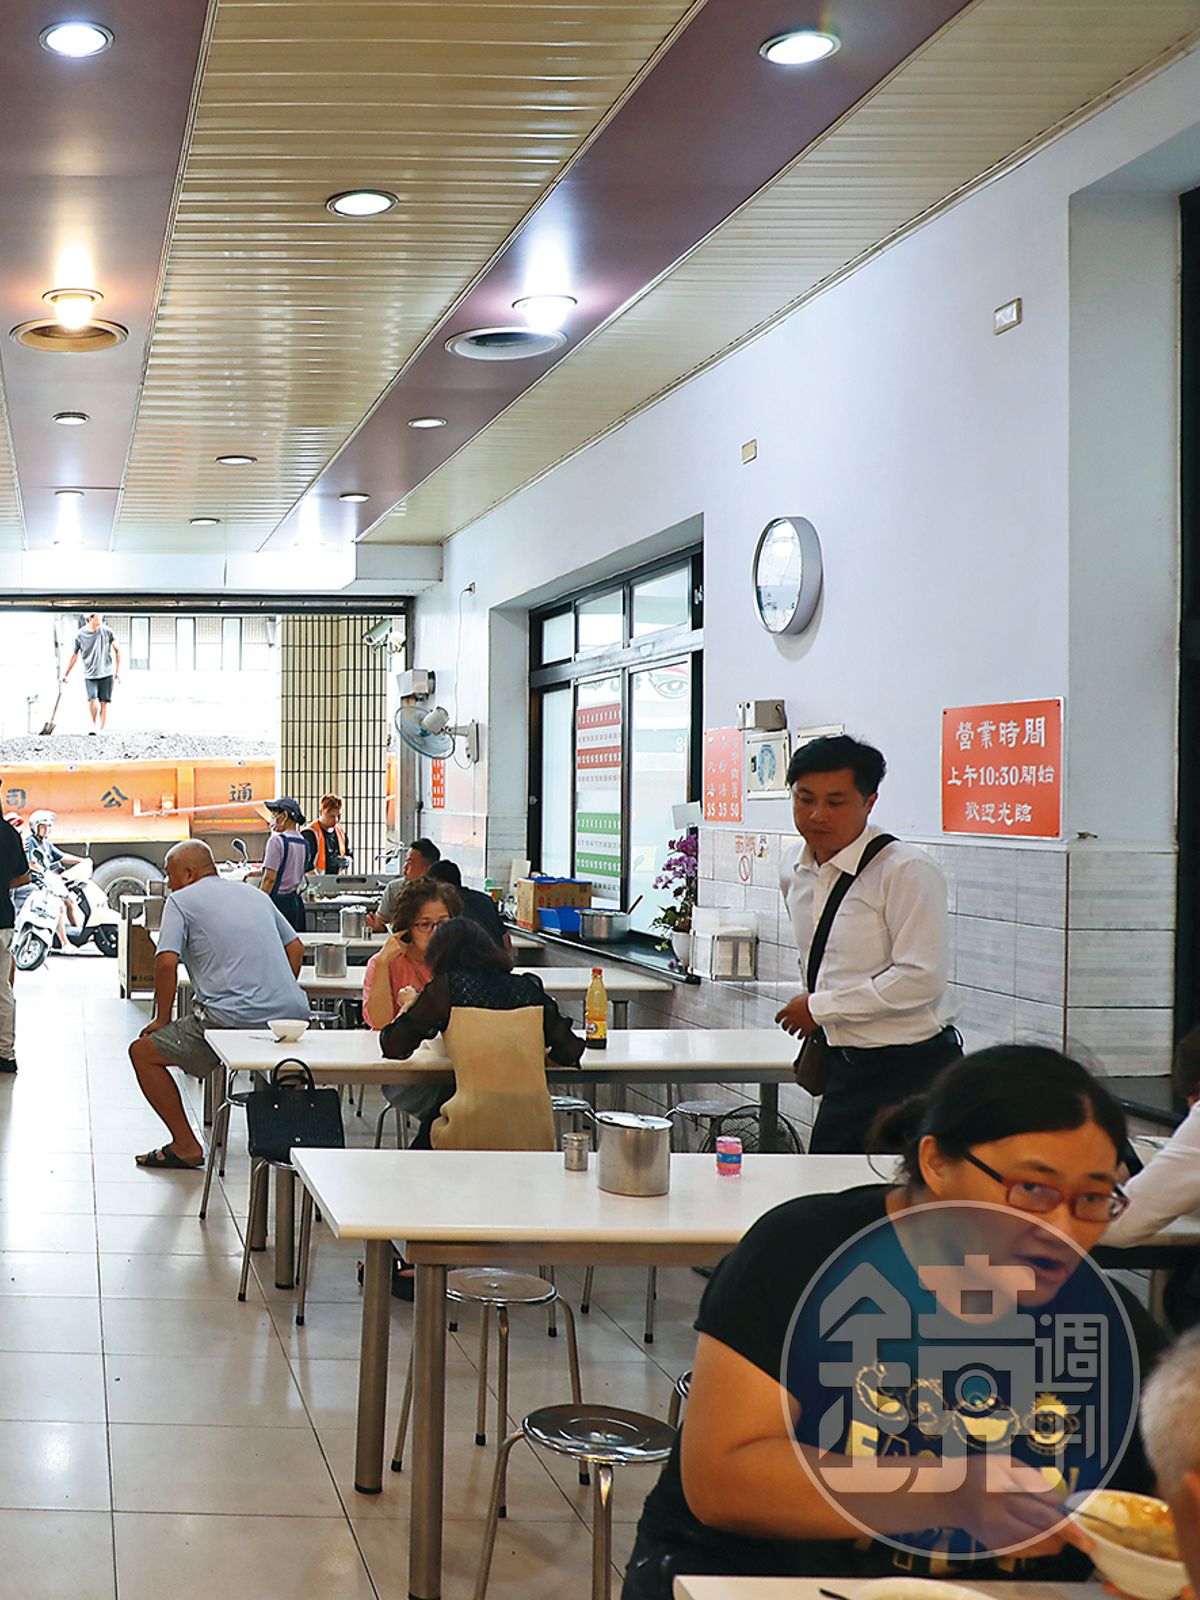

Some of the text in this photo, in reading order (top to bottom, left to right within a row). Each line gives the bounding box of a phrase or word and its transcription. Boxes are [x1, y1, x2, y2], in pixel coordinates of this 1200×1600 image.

[955, 716, 1046, 751] 營業時間
[947, 764, 1055, 788] 上午10:30開始
[965, 801, 1033, 826] 歡迎光臨
